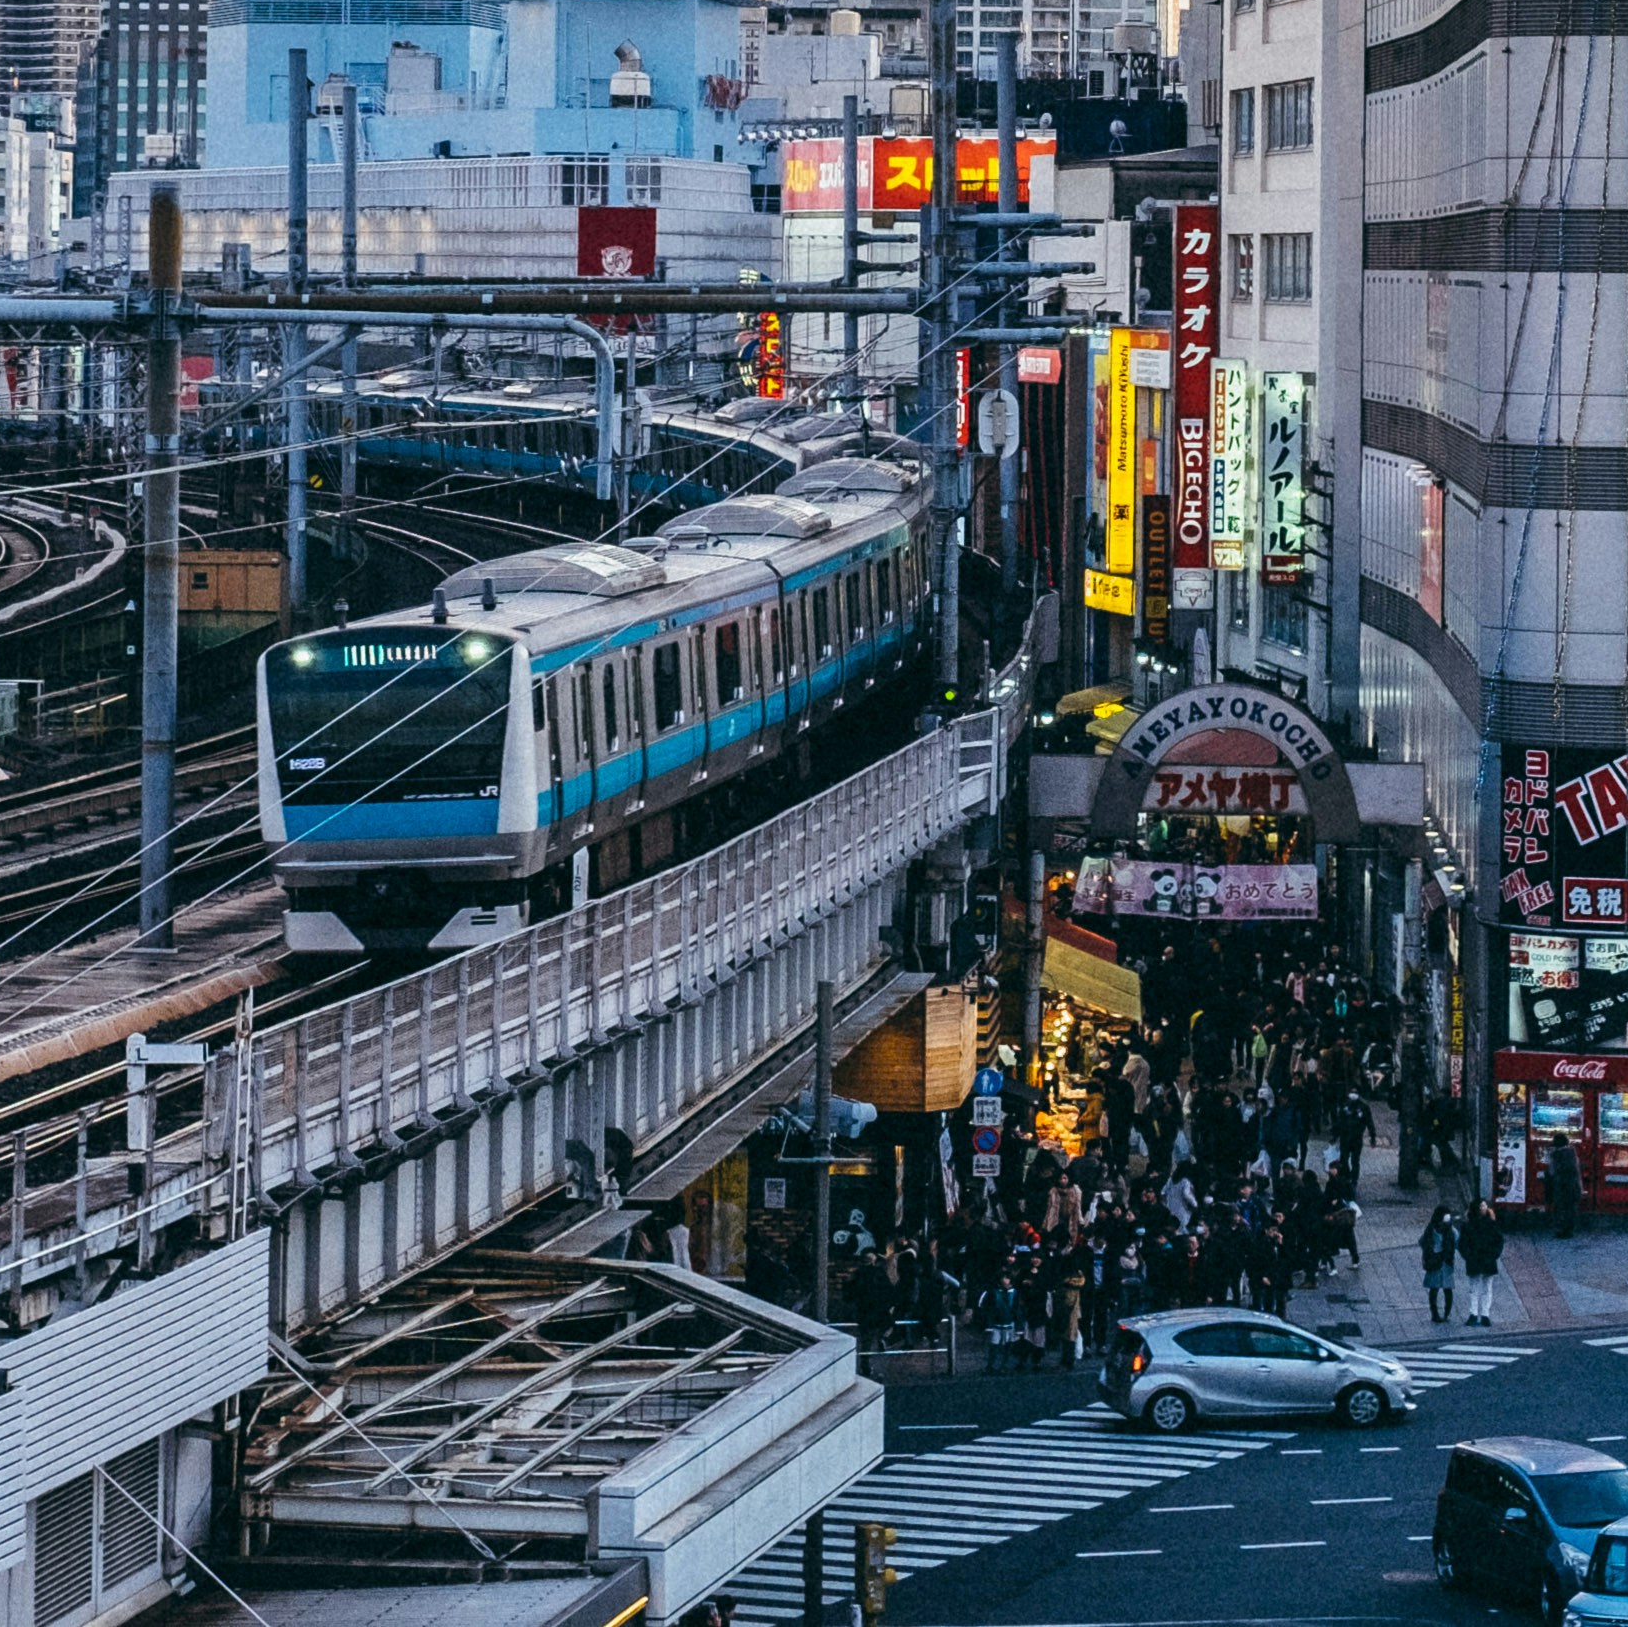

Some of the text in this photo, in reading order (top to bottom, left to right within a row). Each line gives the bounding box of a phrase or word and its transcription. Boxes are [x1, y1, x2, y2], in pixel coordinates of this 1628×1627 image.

[1180, 228, 1212, 369] カラオケ
[1117, 395, 1129, 472] Matsumoto
[1179, 418, 1204, 546] BIG ECHO
[1268, 415, 1297, 554] ルノアール
[1148, 510, 1166, 592] OUTLET
[1123, 696, 1332, 780] AMEYAYOKOCHO
[479, 785, 499, 797] JR
[1153, 770, 1300, 809] アメヤ横丁
[1504, 776, 1523, 863] カメラ
[1523, 749, 1550, 864] ヨドバシ
[1499, 867, 1532, 903] TAX
[1517, 880, 1555, 915] FREE
